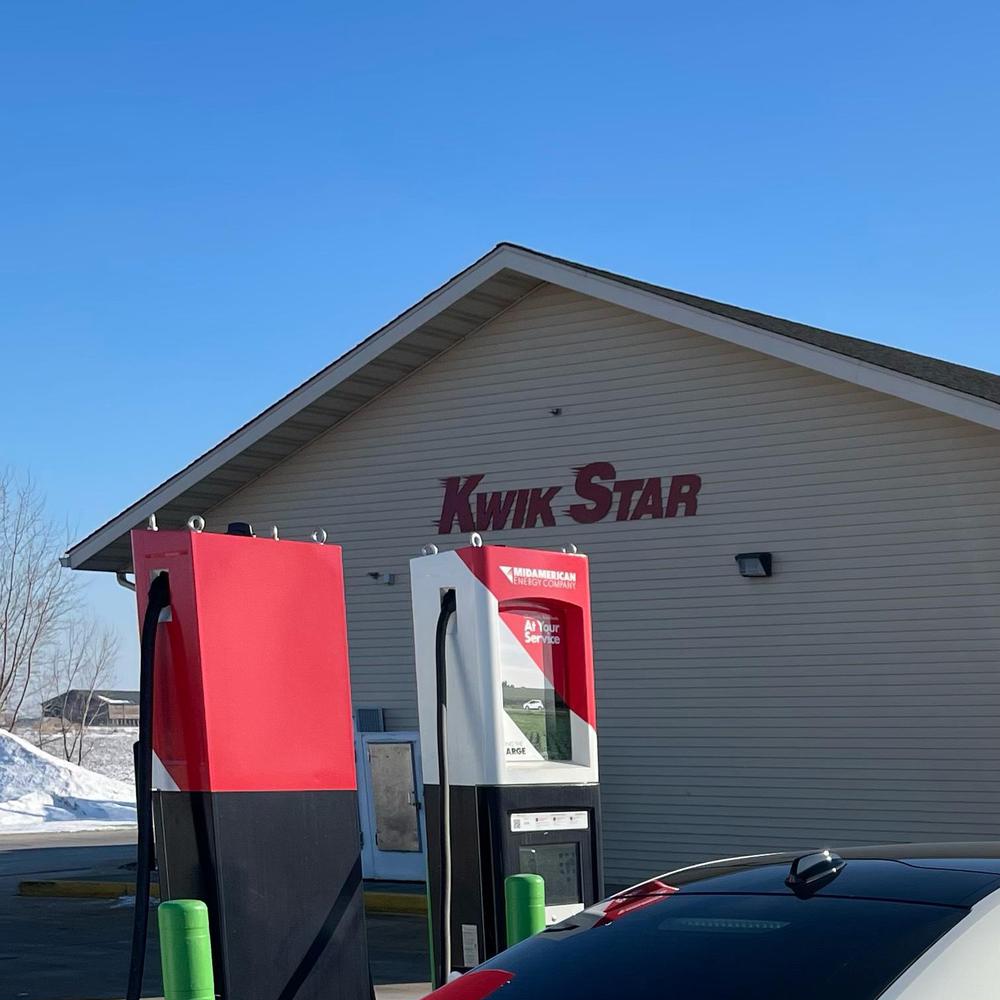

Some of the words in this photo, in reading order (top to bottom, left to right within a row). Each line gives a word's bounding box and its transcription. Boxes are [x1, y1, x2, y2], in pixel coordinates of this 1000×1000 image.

[432, 474, 562, 534] KWIK
[565, 461, 702, 525] STAR
[513, 567, 577, 581] MIDAMERICAN
[513, 577, 541, 587] ENERGY
[543, 579, 576, 589] COMPANY
[524, 619, 536, 631] At
[536, 619, 560, 632] Your
[524, 631, 560, 644] Service
